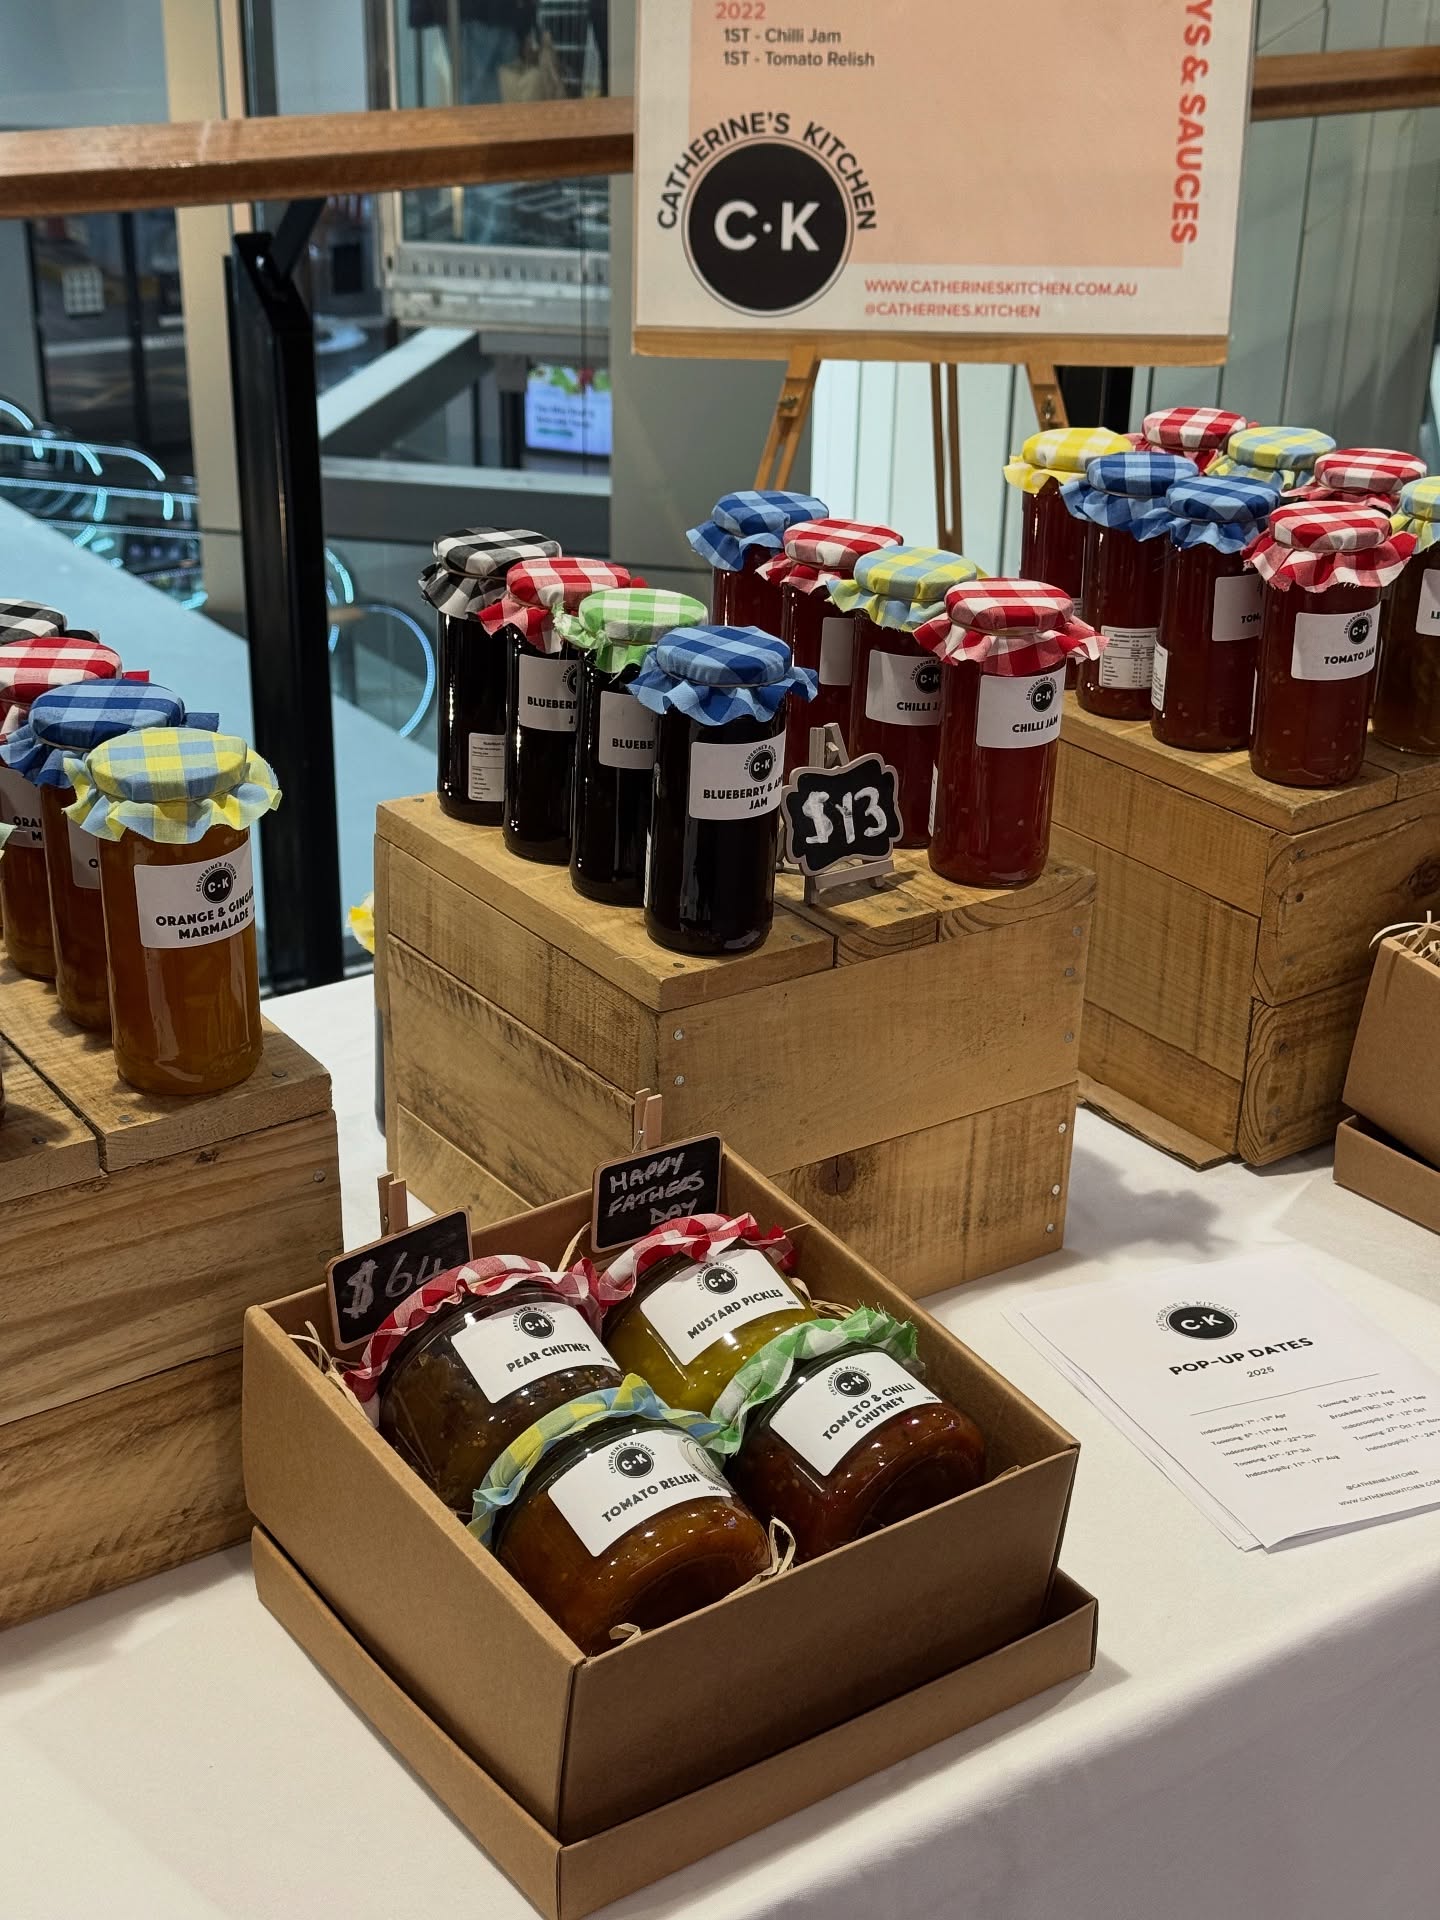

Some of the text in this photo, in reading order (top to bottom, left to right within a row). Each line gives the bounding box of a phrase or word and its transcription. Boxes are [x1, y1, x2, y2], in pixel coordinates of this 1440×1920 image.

[715, 2, 766, 20] 2022
[723, 28, 750, 43] 1ST
[765, 28, 804, 43] Chilli
[808, 28, 842, 43] Jam
[723, 51, 750, 66] 1ST
[765, 51, 823, 66] Tomato
[827, 51, 875, 66] Relish
[1181, 55, 1209, 85] &
[657, 111, 877, 230] CATHERINE'S KITCHEN
[1171, 94, 1206, 244] SAUCES
[864, 279, 1138, 297] WWW.CATHERINESKITCHEN.COM.AU
[864, 303, 1041, 318] @CATHERINES.KITCHEN
[1324, 652, 1364, 665] TOMATO
[896, 702, 931, 711] CHILLI
[1012, 714, 1059, 733] CHILLI JAM
[703, 785, 765, 799] BLUEBERRY
[767, 783, 773, 792] &
[749, 797, 768, 810] JAM
[802, 787, 888, 844] $13
[155, 909, 214, 927] ORANGE
[217, 907, 226, 918] &
[178, 907, 249, 940] MARMALADE
[609, 1153, 685, 1194] HAPPY
[650, 1198, 698, 1225] DAY
[687, 1289, 783, 1339] MUSTARD PICKLES
[1156, 1300, 1240, 1332] CATHERINE'S KITCHEN
[506, 1343, 591, 1373] PEAR CHUTNEY
[1168, 1337, 1314, 1375] POP-UP DATES
[1246, 1366, 1275, 1378] 2025
[822, 1383, 916, 1441] TOMATO & CHILLI
[855, 1397, 905, 1429] CHUTNEY
[602, 1473, 700, 1522] TOMATO RELISH
